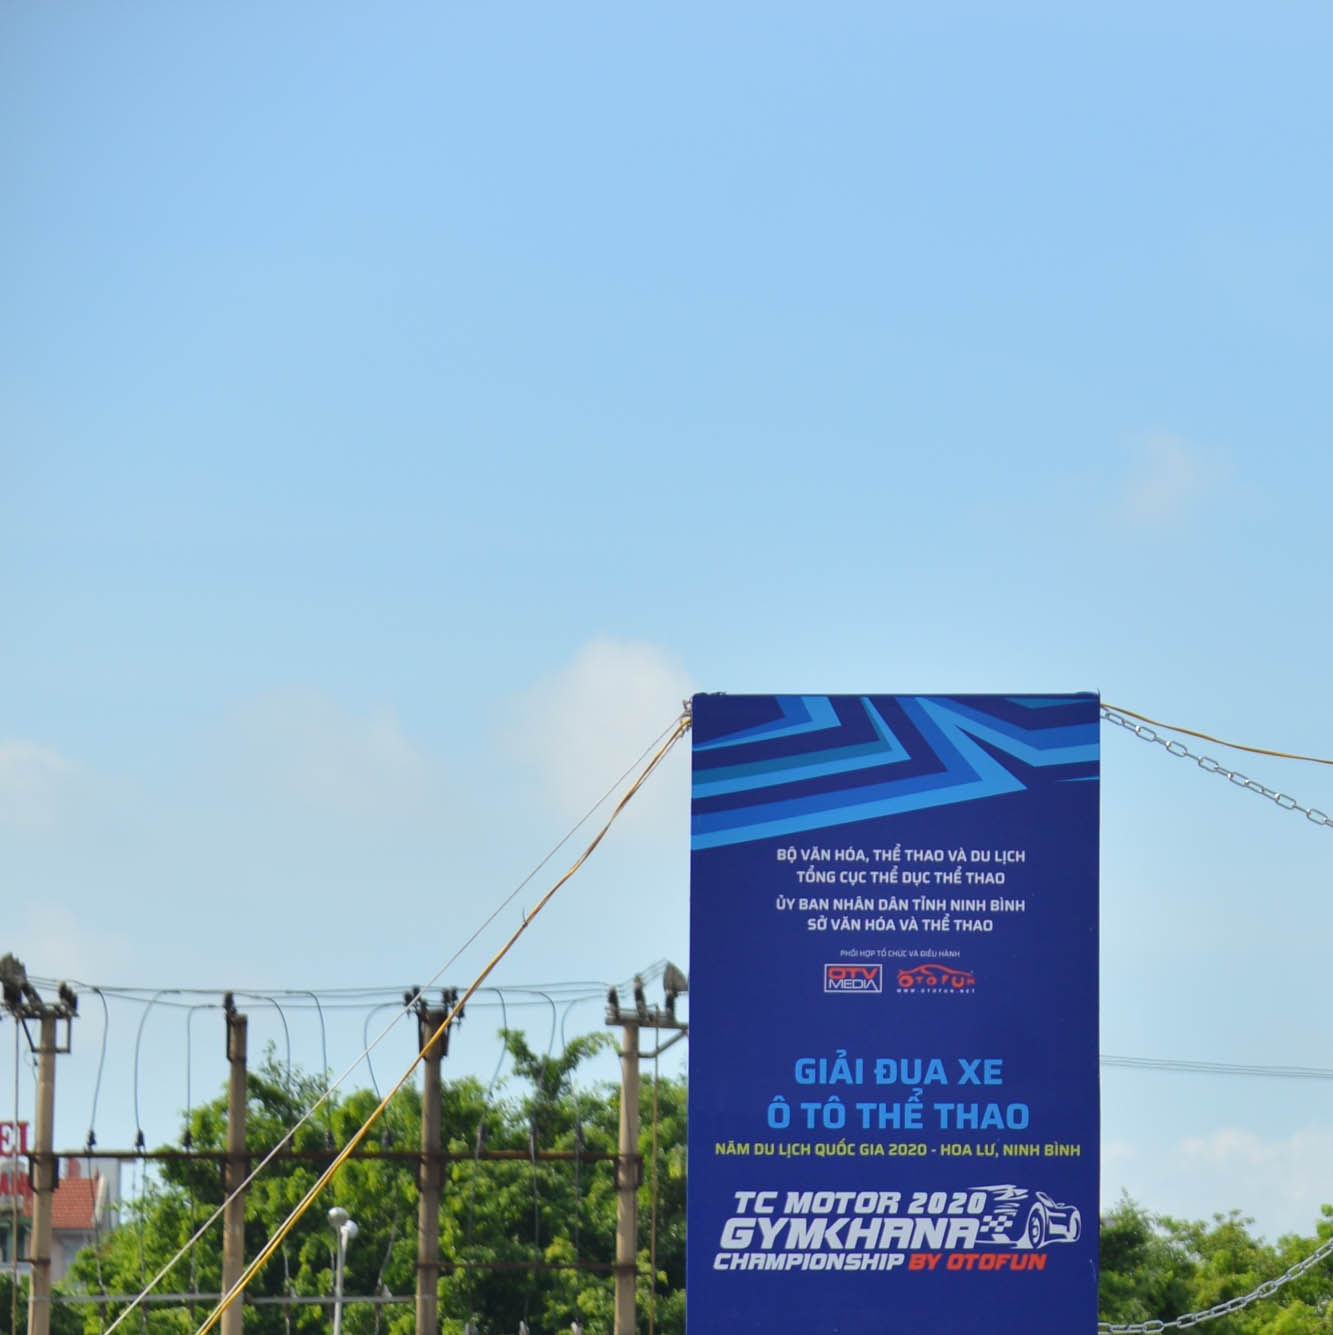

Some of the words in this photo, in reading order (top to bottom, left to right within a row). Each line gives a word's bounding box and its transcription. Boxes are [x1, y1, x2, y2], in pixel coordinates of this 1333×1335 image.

[776, 845, 798, 864] BỘ
[800, 845, 831, 864] VĂN
[834, 846, 870, 863] HÓA,
[872, 843, 901, 863] THỂ
[904, 849, 945, 863] THAO
[947, 847, 968, 863] VÀ
[970, 849, 991, 863] DU
[994, 849, 1026, 865] LỊCH
[796, 865, 836, 884] TỔNG
[839, 870, 867, 887] CỤC
[869, 866, 899, 885] THỂ
[901, 871, 931, 887] DỤC
[933, 865, 963, 885] THỂ
[965, 871, 1006, 885] THAO
[798, 897, 830, 911] BAN
[832, 895, 875, 911] NHÂN
[877, 895, 909, 912] DÂN
[911, 895, 947, 912] TỈNH
[950, 899, 987, 912] NINH
[989, 896, 1026, 912] BÌNH
[807, 914, 828, 931] SỞ
[830, 915, 862, 931] VĂN
[864, 915, 897, 932] HÓA
[898, 915, 919, 932] VÀ
[921, 912, 950, 932] THỂ
[953, 919, 994, 932] THAO
[794, 1048, 864, 1085] GIẢI
[873, 1058, 949, 1086] ĐUA
[957, 1058, 1003, 1086] XE
[767, 1094, 791, 1130] Ô
[800, 1094, 846, 1130] TÔ
[855, 1087, 924, 1130] THỂ
[933, 1102, 1030, 1130] THAO
[714, 1140, 751, 1156] NĂM
[753, 1142, 776, 1156] DU
[778, 1142, 812, 1158] LỊCH
[813, 1138, 856, 1158] QUỐC
[858, 1143, 885, 1157] GIA
[888, 1143, 928, 1157] 2020
[939, 1143, 973, 1157] HOA
[975, 1142, 999, 1158] LƯ,
[1002, 1143, 1041, 1157] NINH
[1043, 1141, 1082, 1157] BÌNH
[734, 1191, 779, 1215] TC
[783, 1191, 902, 1215] MOTOR
[907, 1191, 987, 1215] 2020
[719, 1217, 982, 1251] GYMKHANA
[712, 1252, 905, 1271] CHAMPIONSHIP
[908, 1252, 942, 1271] BY
[946, 1252, 1048, 1271] OTOFUN
